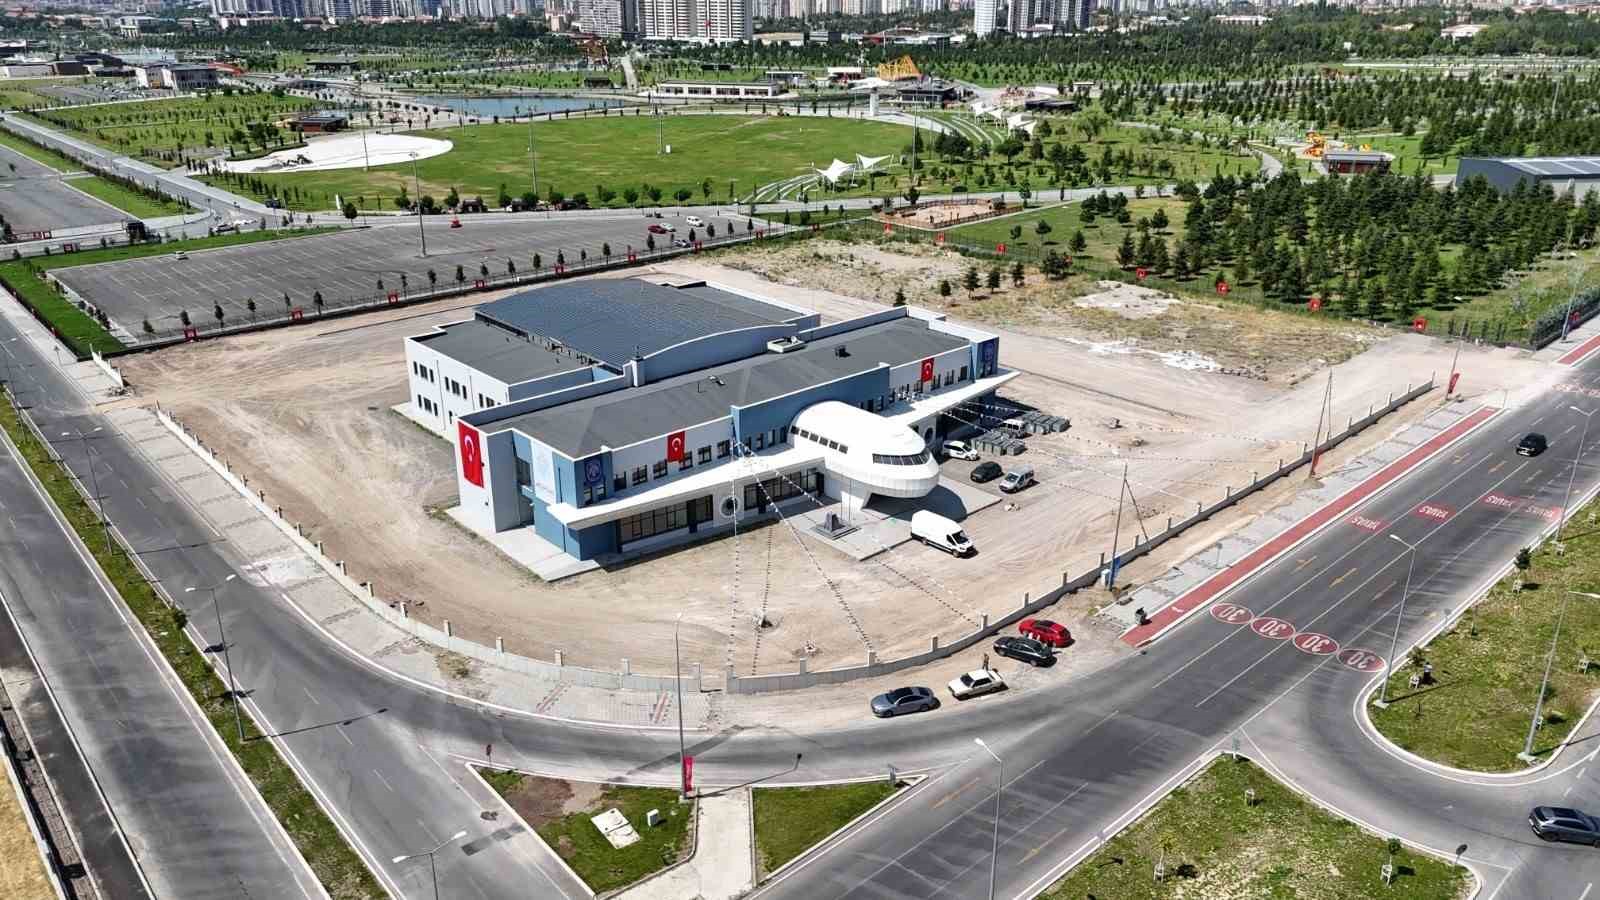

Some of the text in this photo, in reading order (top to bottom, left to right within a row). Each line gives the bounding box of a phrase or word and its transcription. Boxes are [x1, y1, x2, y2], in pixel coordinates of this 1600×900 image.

[1220, 606, 1245, 621] 30
[1260, 620, 1287, 636] 30
[1302, 636, 1330, 652] 30
[1348, 652, 1375, 668] 30
